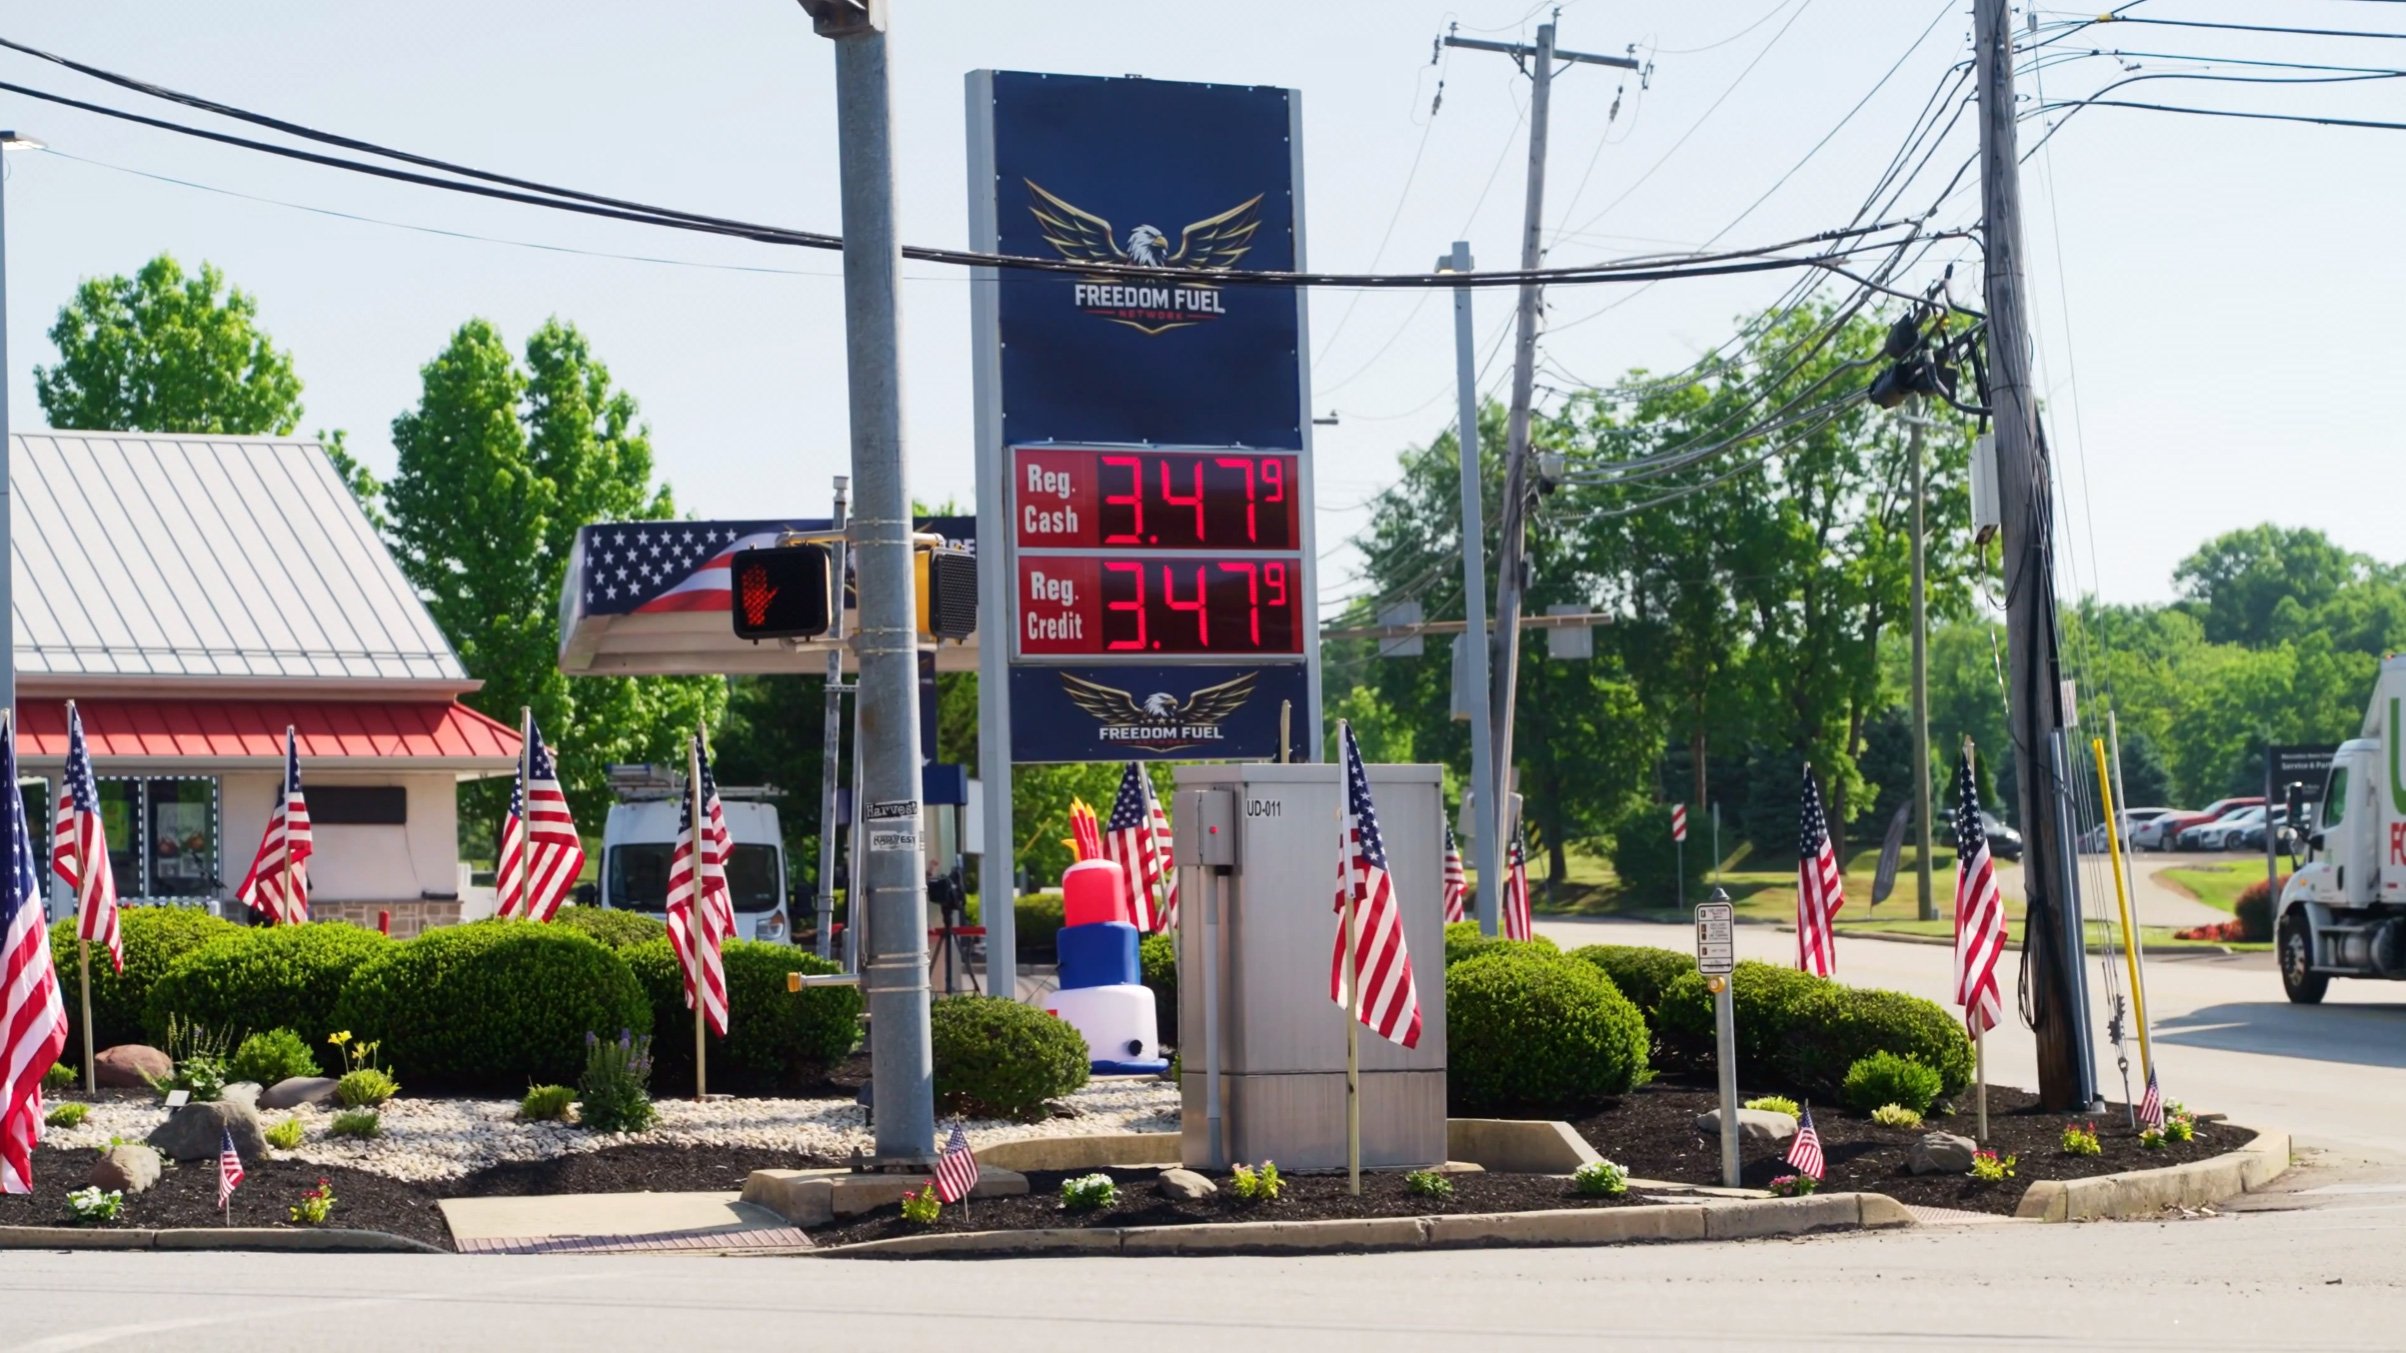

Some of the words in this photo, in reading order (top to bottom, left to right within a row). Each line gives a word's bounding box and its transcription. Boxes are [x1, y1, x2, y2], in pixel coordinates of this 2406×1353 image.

[1075, 284, 1168, 309] FREEDOM
[1174, 289, 1226, 314] FUEL
[1027, 464, 1076, 499] Reg.
[1024, 502, 1079, 533] Cash
[1030, 571, 1079, 606] Reg.
[1028, 611, 1083, 640] Credit
[1099, 727, 1177, 740] FREEDOM
[1181, 726, 1224, 739] FUEL
[866, 801, 918, 818] Harvest
[1247, 800, 1281, 816] UD-011
